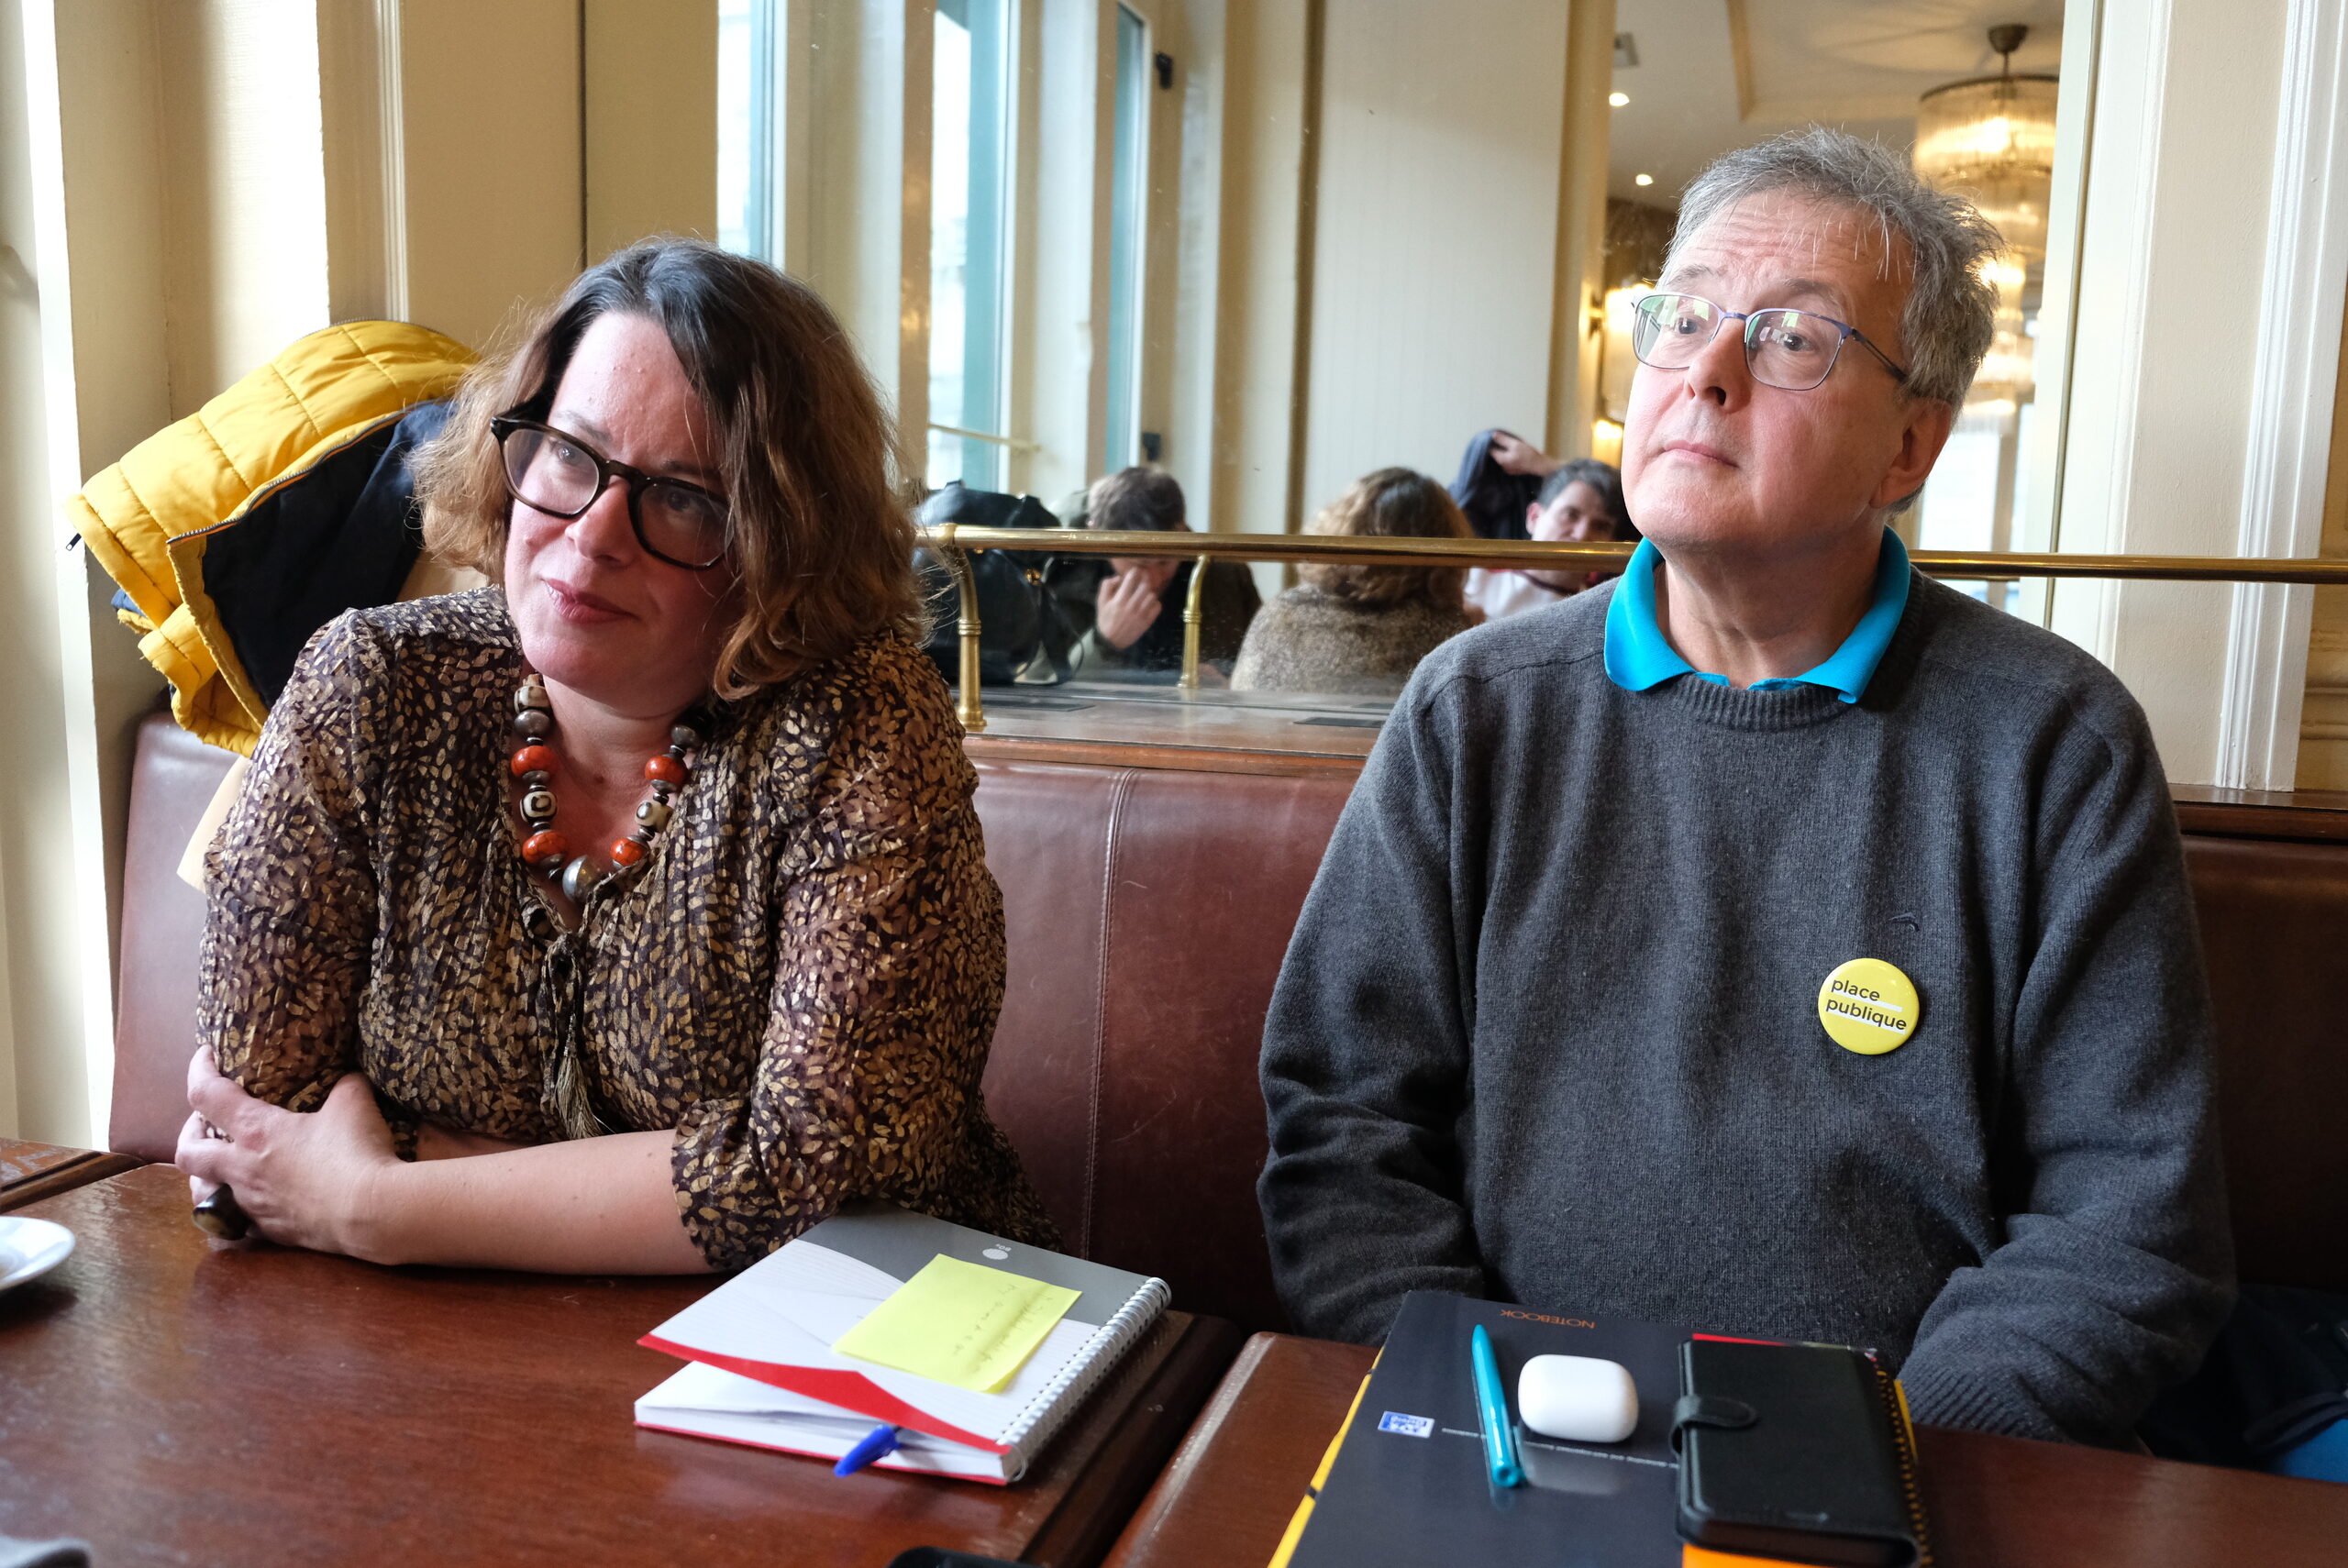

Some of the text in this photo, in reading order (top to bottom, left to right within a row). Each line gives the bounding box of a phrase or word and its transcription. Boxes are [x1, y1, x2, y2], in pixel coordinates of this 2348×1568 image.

[1831, 979, 1880, 1001] place
[1825, 999, 1907, 1030] publique
[1500, 1309, 1596, 1329] NOTEBOOK
